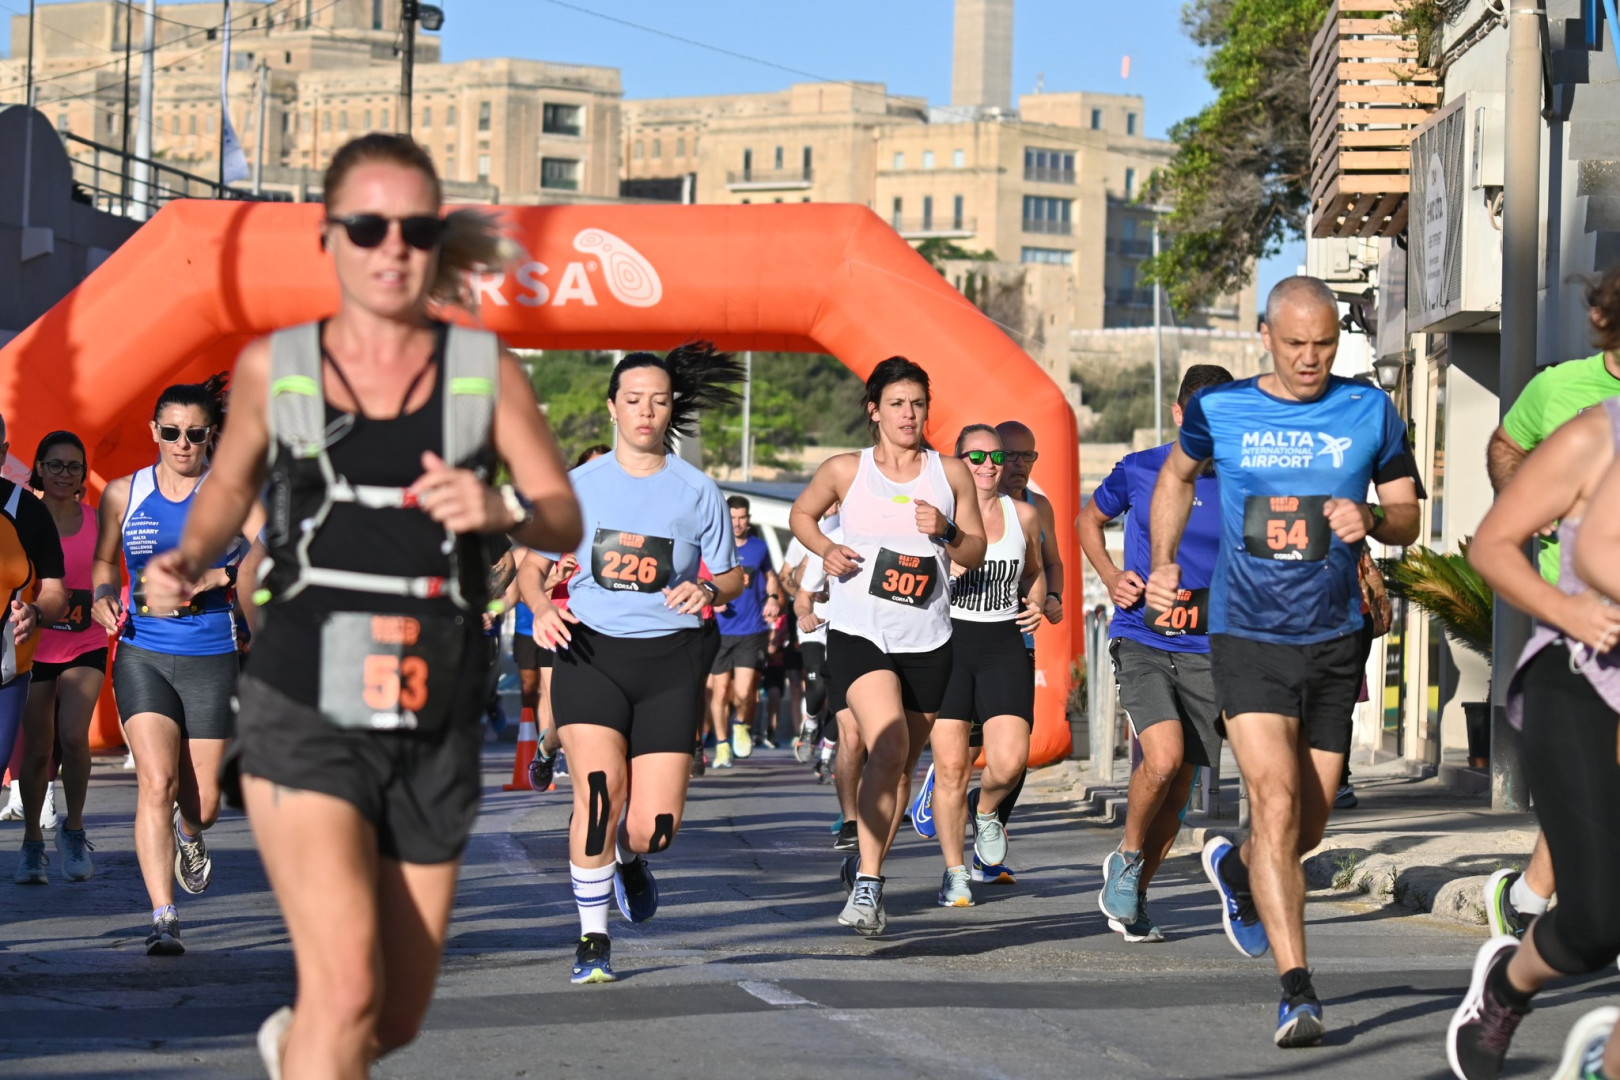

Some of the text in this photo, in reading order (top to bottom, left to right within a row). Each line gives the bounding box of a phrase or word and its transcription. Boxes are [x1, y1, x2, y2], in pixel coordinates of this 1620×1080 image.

[1242, 431, 1314, 447] MALTA
[1240, 455, 1314, 468] AIRPORT
[1241, 447, 1313, 456] INTERNATIONAL
[1266, 519, 1309, 550] 54
[600, 550, 658, 584] 226
[613, 582, 633, 591] CORSA
[882, 568, 930, 597] 307
[891, 595, 909, 604] CORSA
[1154, 605, 1199, 629] 201
[362, 654, 429, 712] 53
